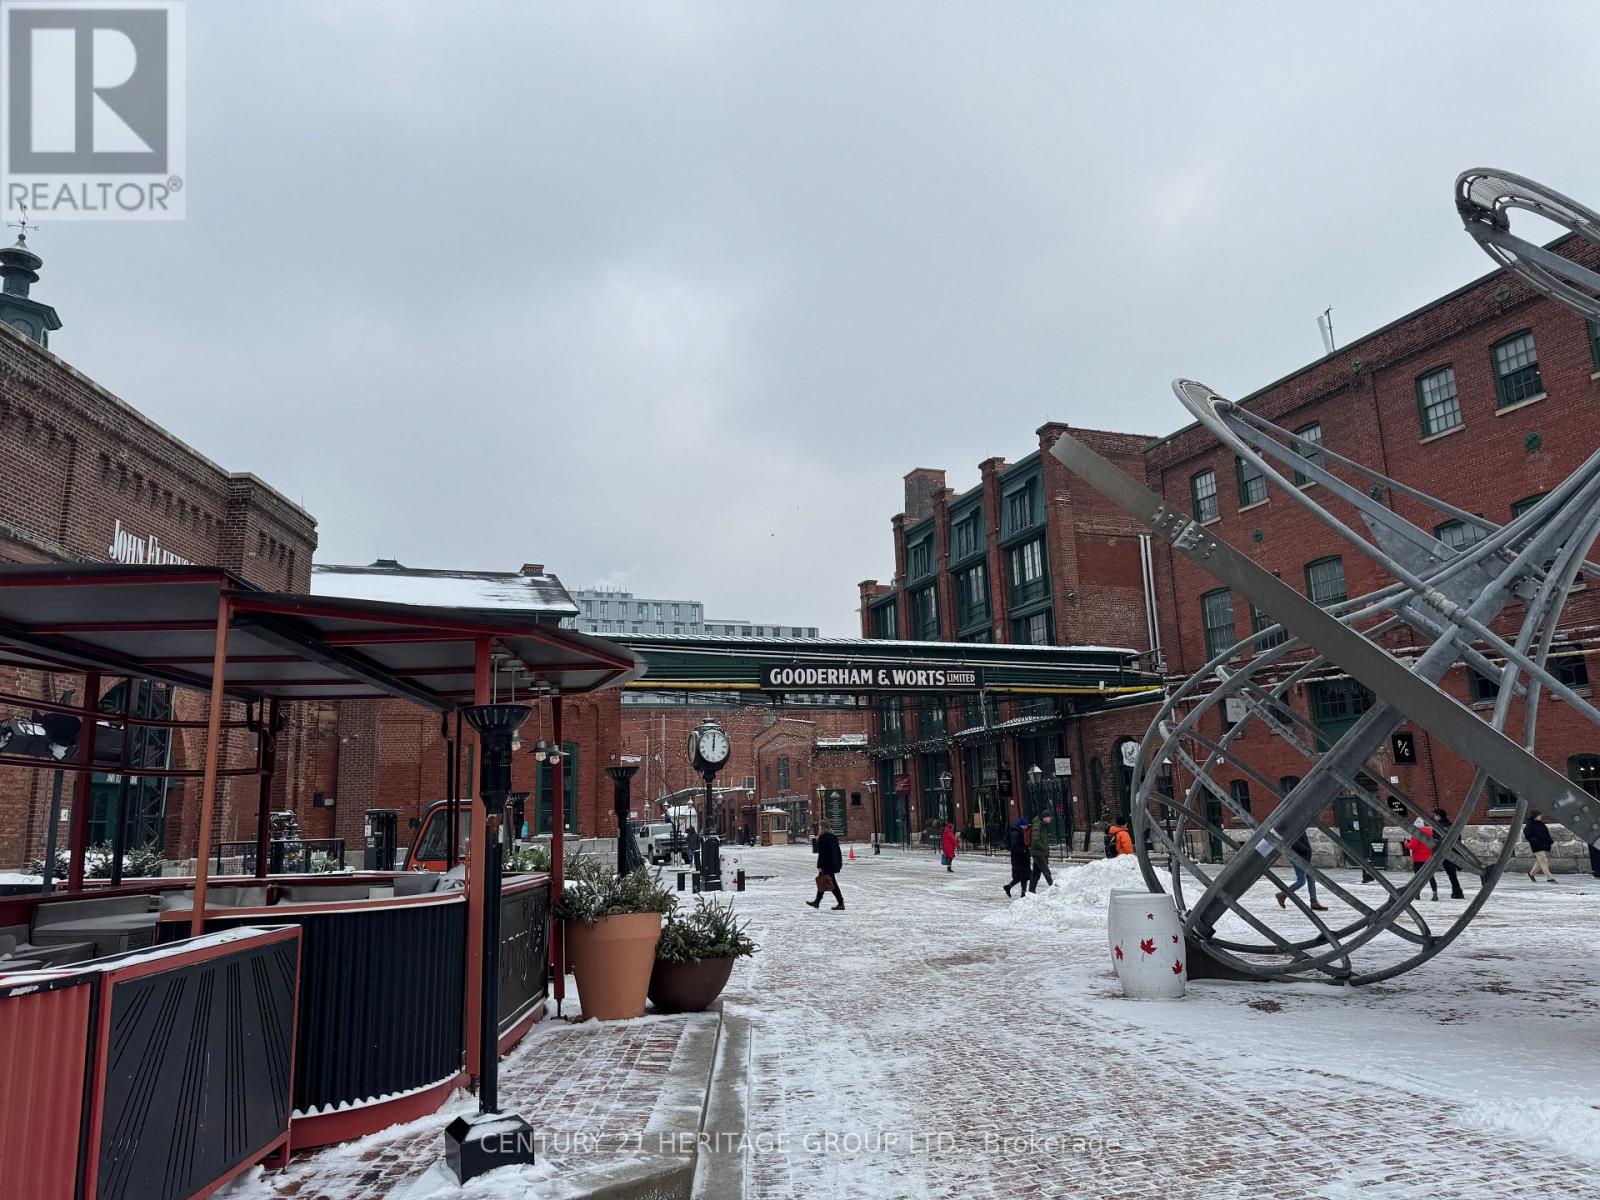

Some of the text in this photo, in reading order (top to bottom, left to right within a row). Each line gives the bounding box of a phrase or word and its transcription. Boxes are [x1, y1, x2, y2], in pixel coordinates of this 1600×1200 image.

[109, 519, 146, 565] JOHN
[769, 668, 976, 686] GOODERHAM & WORTS LIMITED
